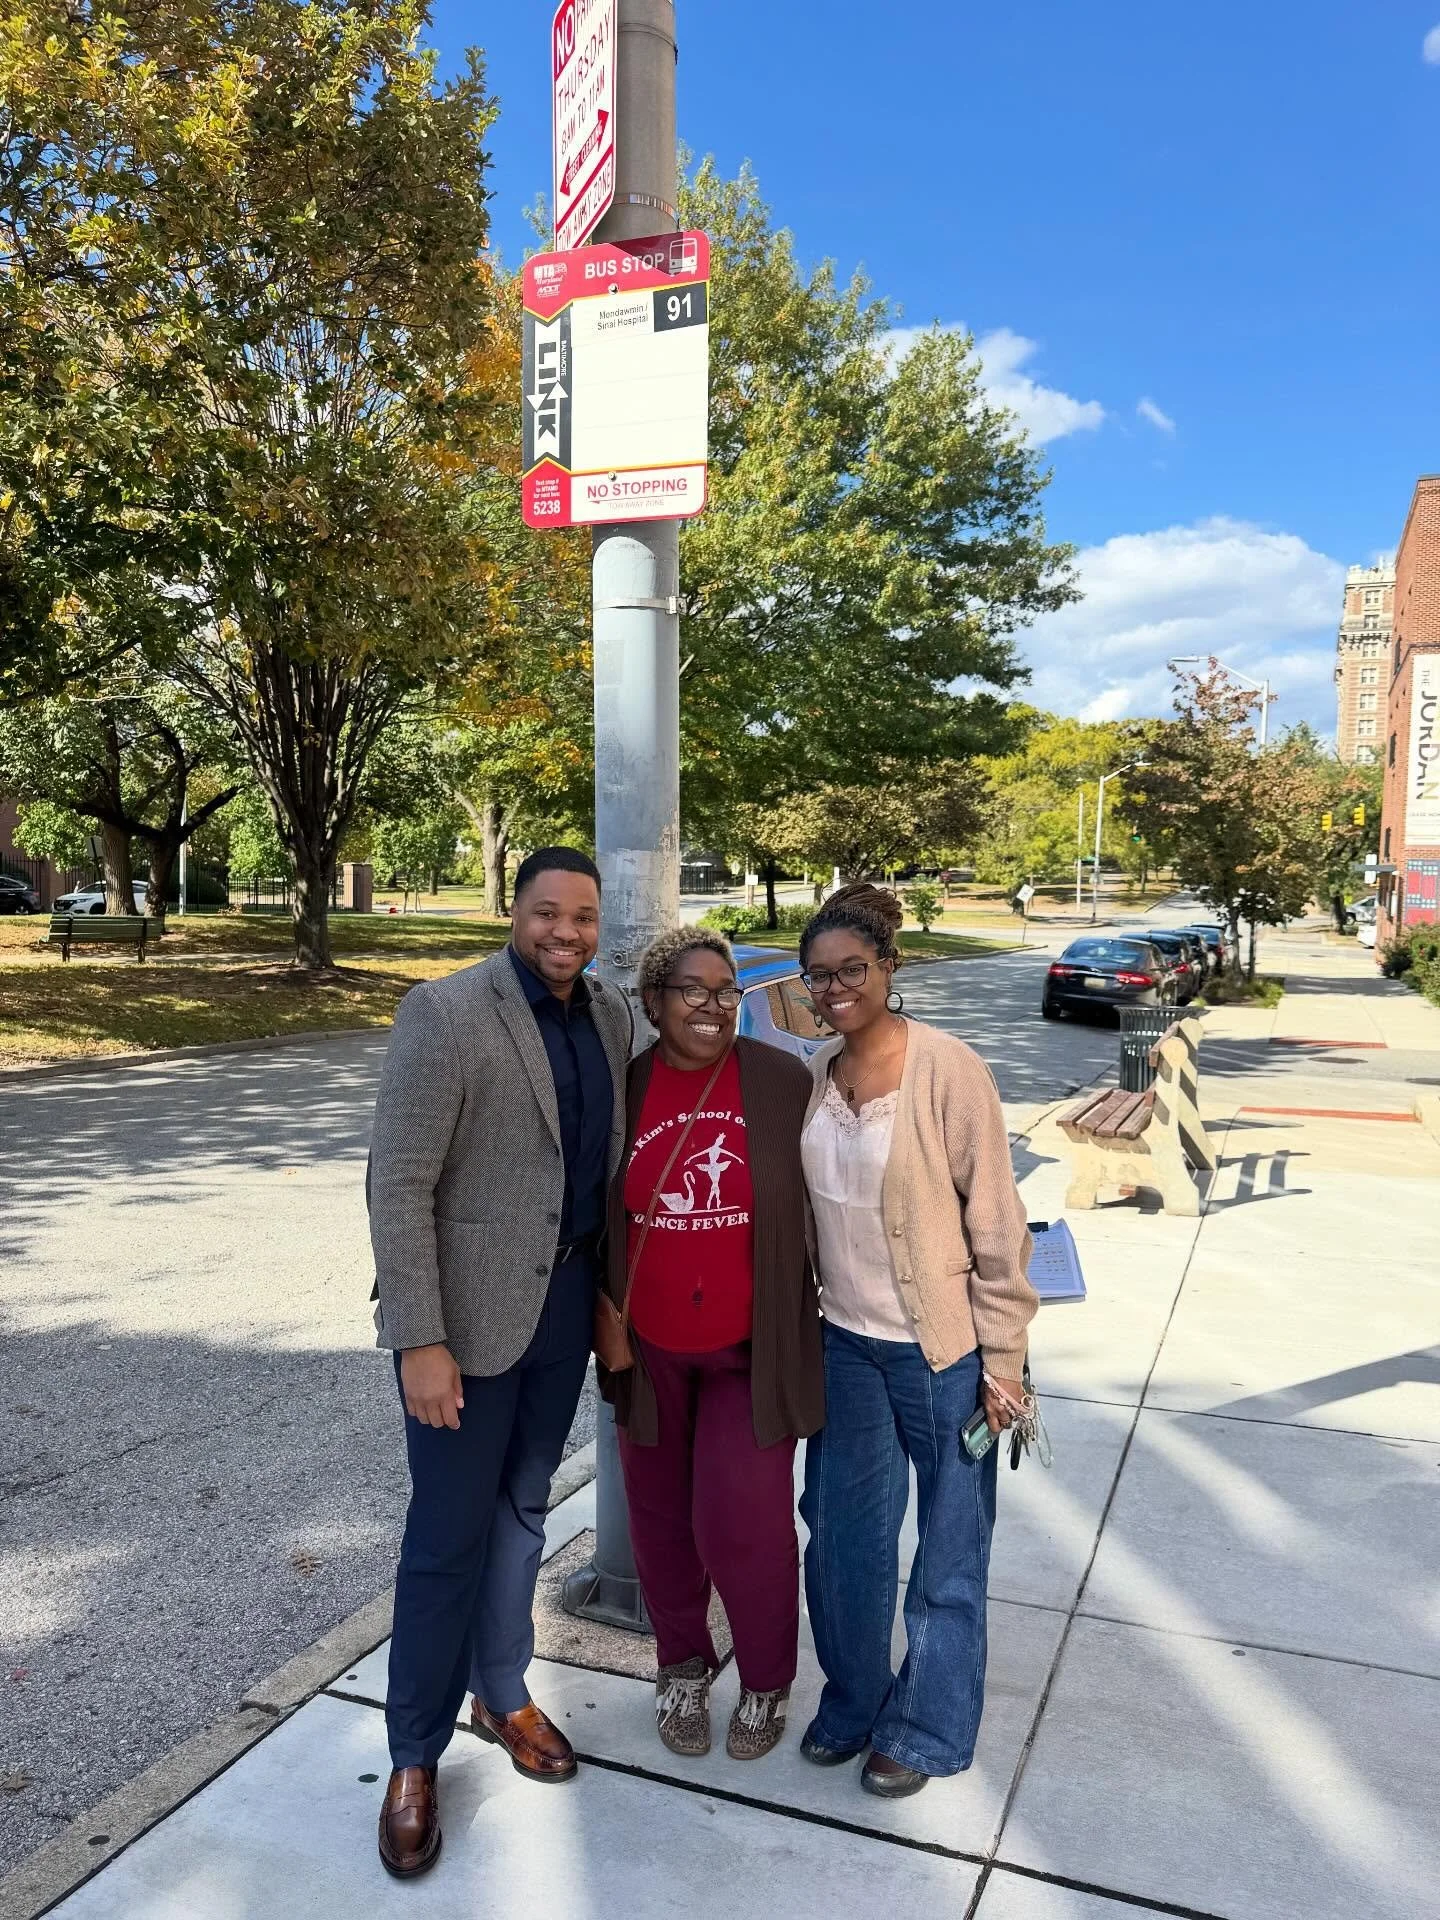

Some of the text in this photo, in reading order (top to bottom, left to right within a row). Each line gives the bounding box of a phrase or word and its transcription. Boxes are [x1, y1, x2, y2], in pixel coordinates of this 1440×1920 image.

[556, 4, 575, 74] NO
[558, 6, 611, 120] THURSDAY
[562, 64, 605, 155] 8AM TO 11AM
[593, 161, 610, 209] ZONE
[585, 252, 665, 279] BUS STOP
[599, 304, 644, 320] Mondawmin
[667, 292, 691, 321] 91
[597, 313, 649, 331] Sinai Hospital
[587, 478, 688, 498] NO STOPPING
[533, 499, 561, 515] 5238
[1420, 669, 1431, 686] THE
[635, 1120, 674, 1149] Kim's
[691, 1212, 749, 1230] FEVER
